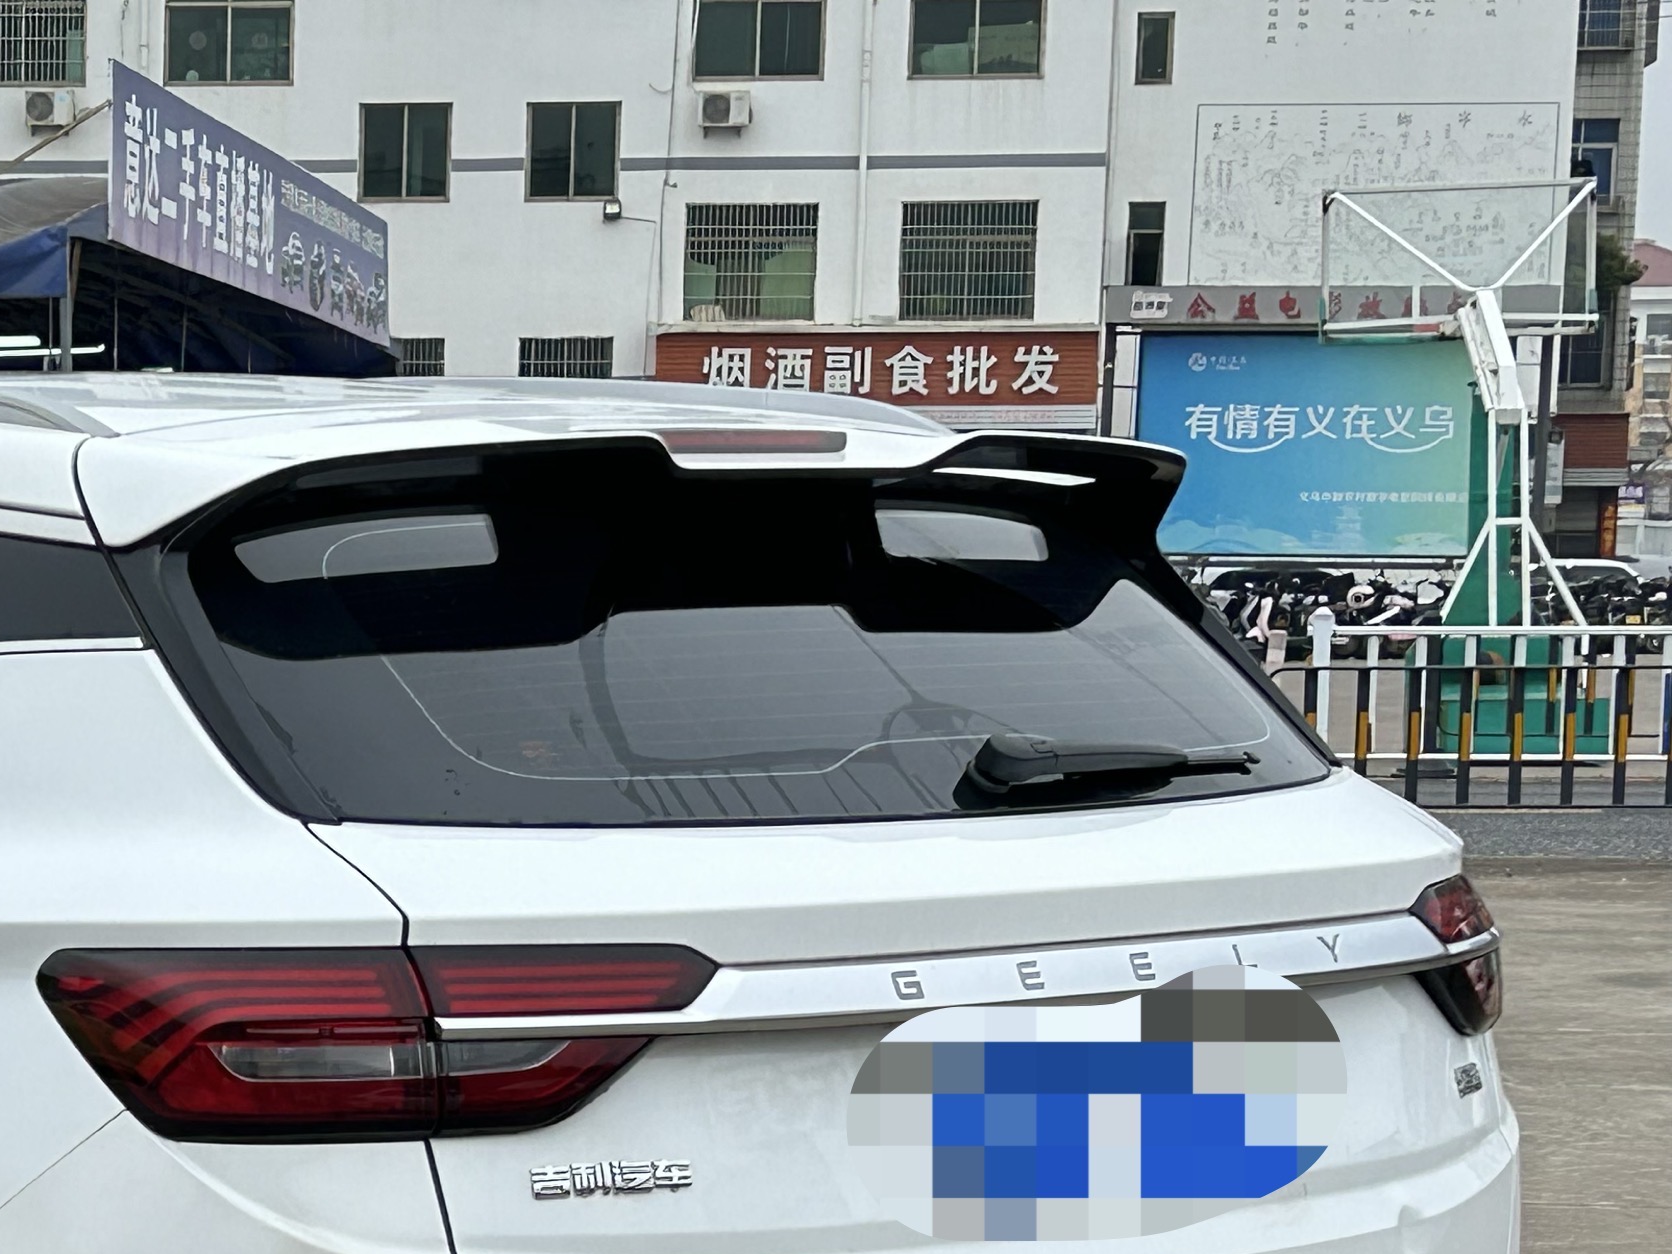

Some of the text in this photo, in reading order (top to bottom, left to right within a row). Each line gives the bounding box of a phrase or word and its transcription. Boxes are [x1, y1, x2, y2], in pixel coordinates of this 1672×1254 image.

[702, 345, 1061, 396] 烟酒副食批发
[1185, 404, 1454, 442] 有情有义在义乌
[890, 933, 1341, 1001] GEELY
[530, 1159, 694, 1199] 吉利汽车
